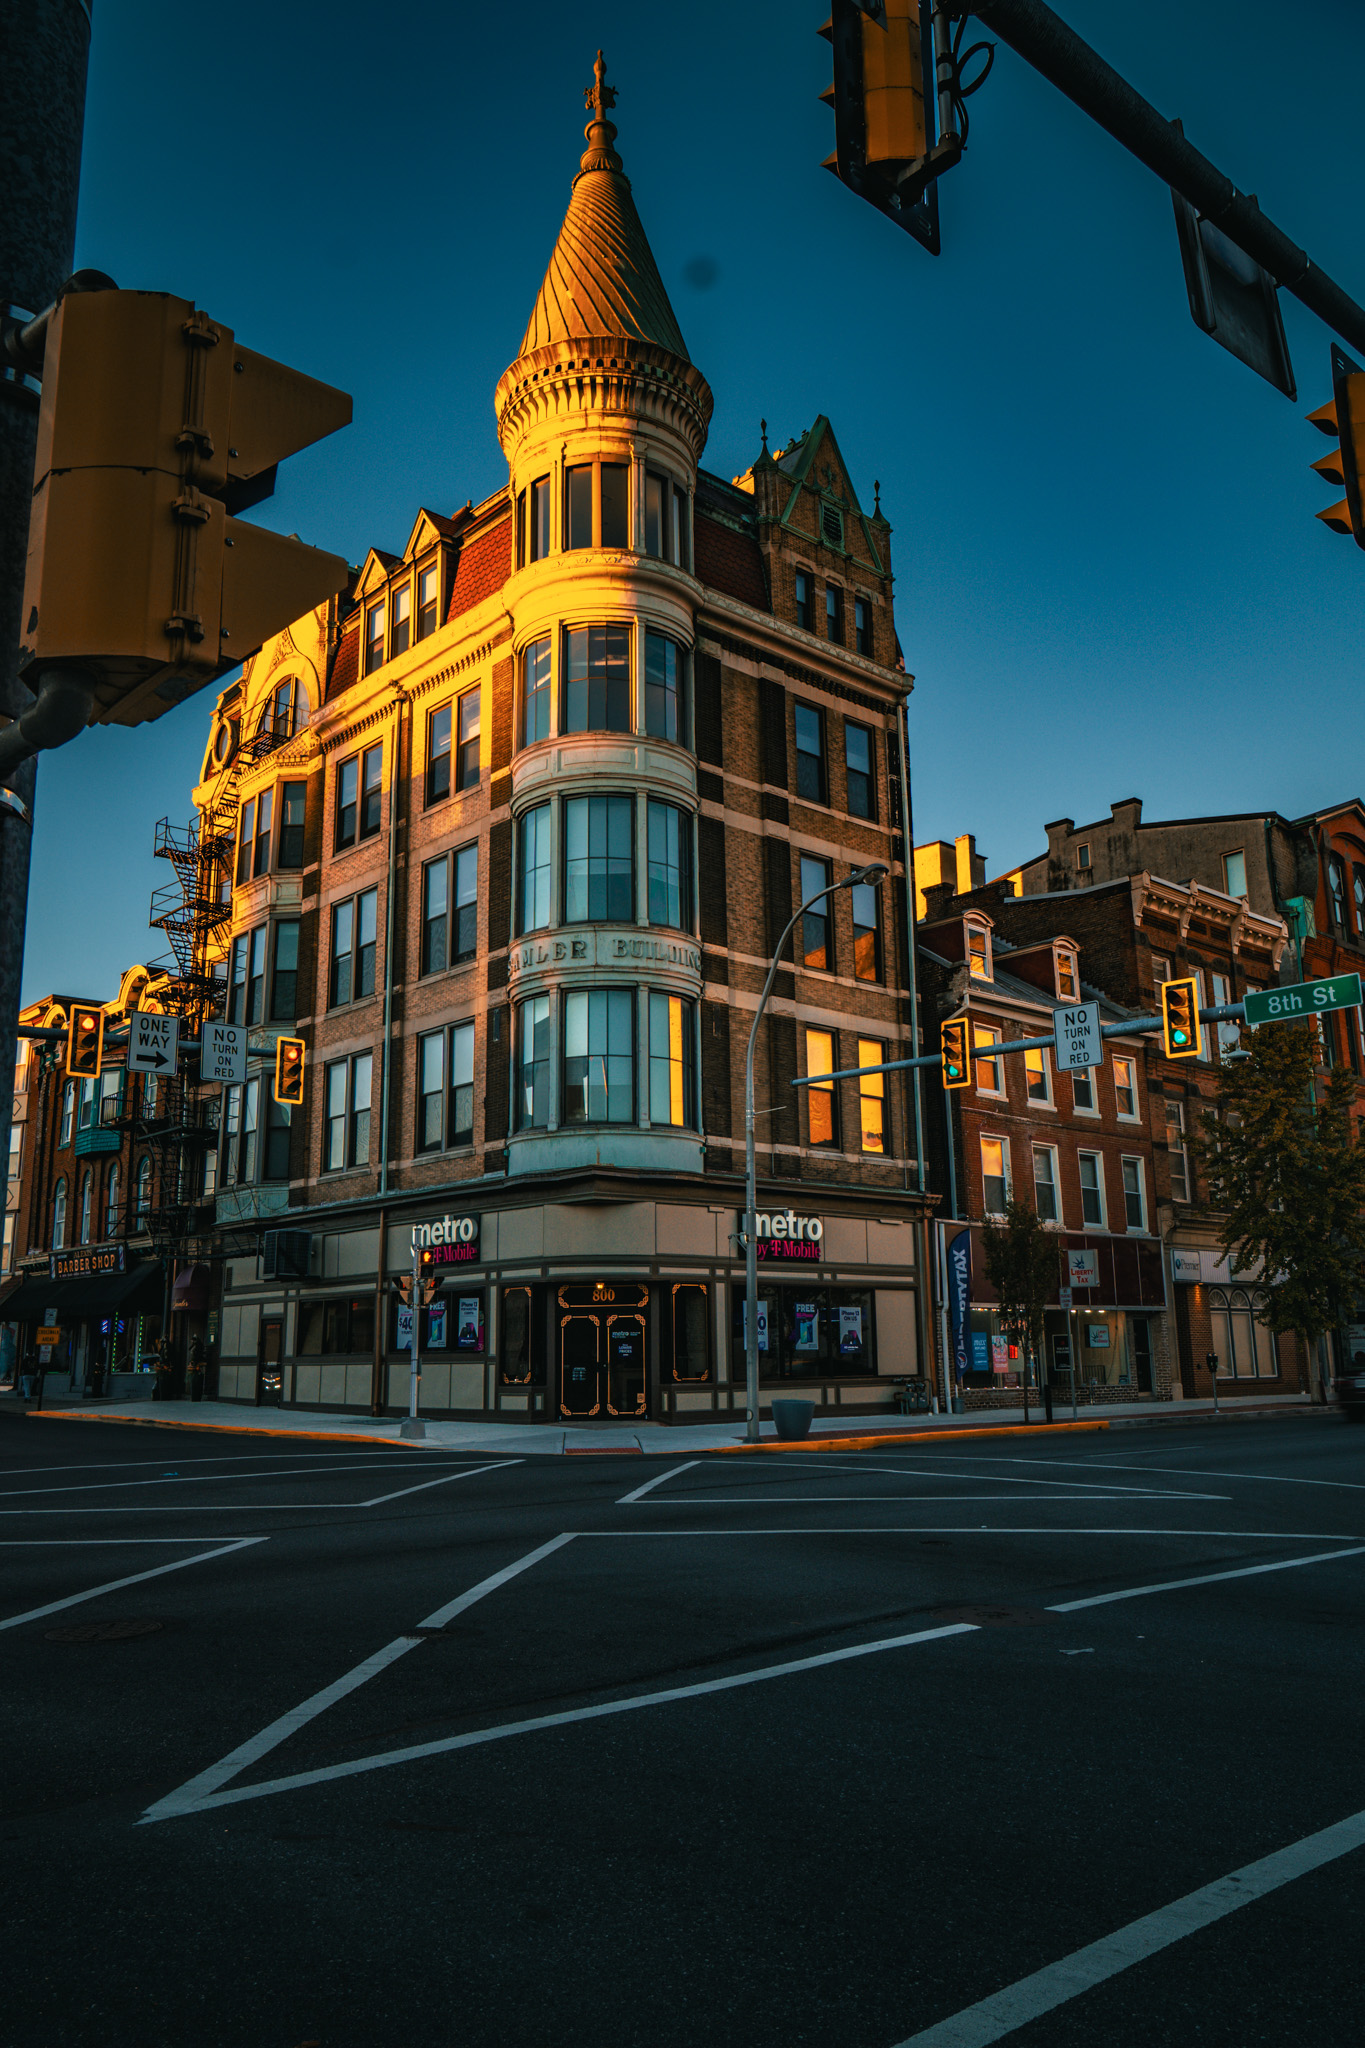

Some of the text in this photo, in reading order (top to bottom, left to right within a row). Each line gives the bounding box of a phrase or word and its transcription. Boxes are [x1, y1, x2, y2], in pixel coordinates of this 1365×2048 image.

[1267, 986, 1337, 1014] 8th St
[1065, 1010, 1087, 1026] NO
[140, 1018, 170, 1034] ONE
[1064, 1025, 1091, 1039] TURN
[139, 1033, 170, 1048] WAY
[214, 1029, 237, 1043] NO
[212, 1044, 238, 1055] TURN
[1071, 1040, 1085, 1051] ON
[217, 1056, 231, 1066] ON
[1070, 1052, 1090, 1064] RED
[214, 1068, 234, 1078] RED
[412, 1215, 475, 1247] metro
[755, 1210, 824, 1242] metro
[58, 1258, 90, 1274] BARBER
[92, 1254, 116, 1270] SHOP
[1070, 1268, 1093, 1276] LIBERTY
[592, 1288, 615, 1302] 800
[796, 1303, 816, 1313] FREE
